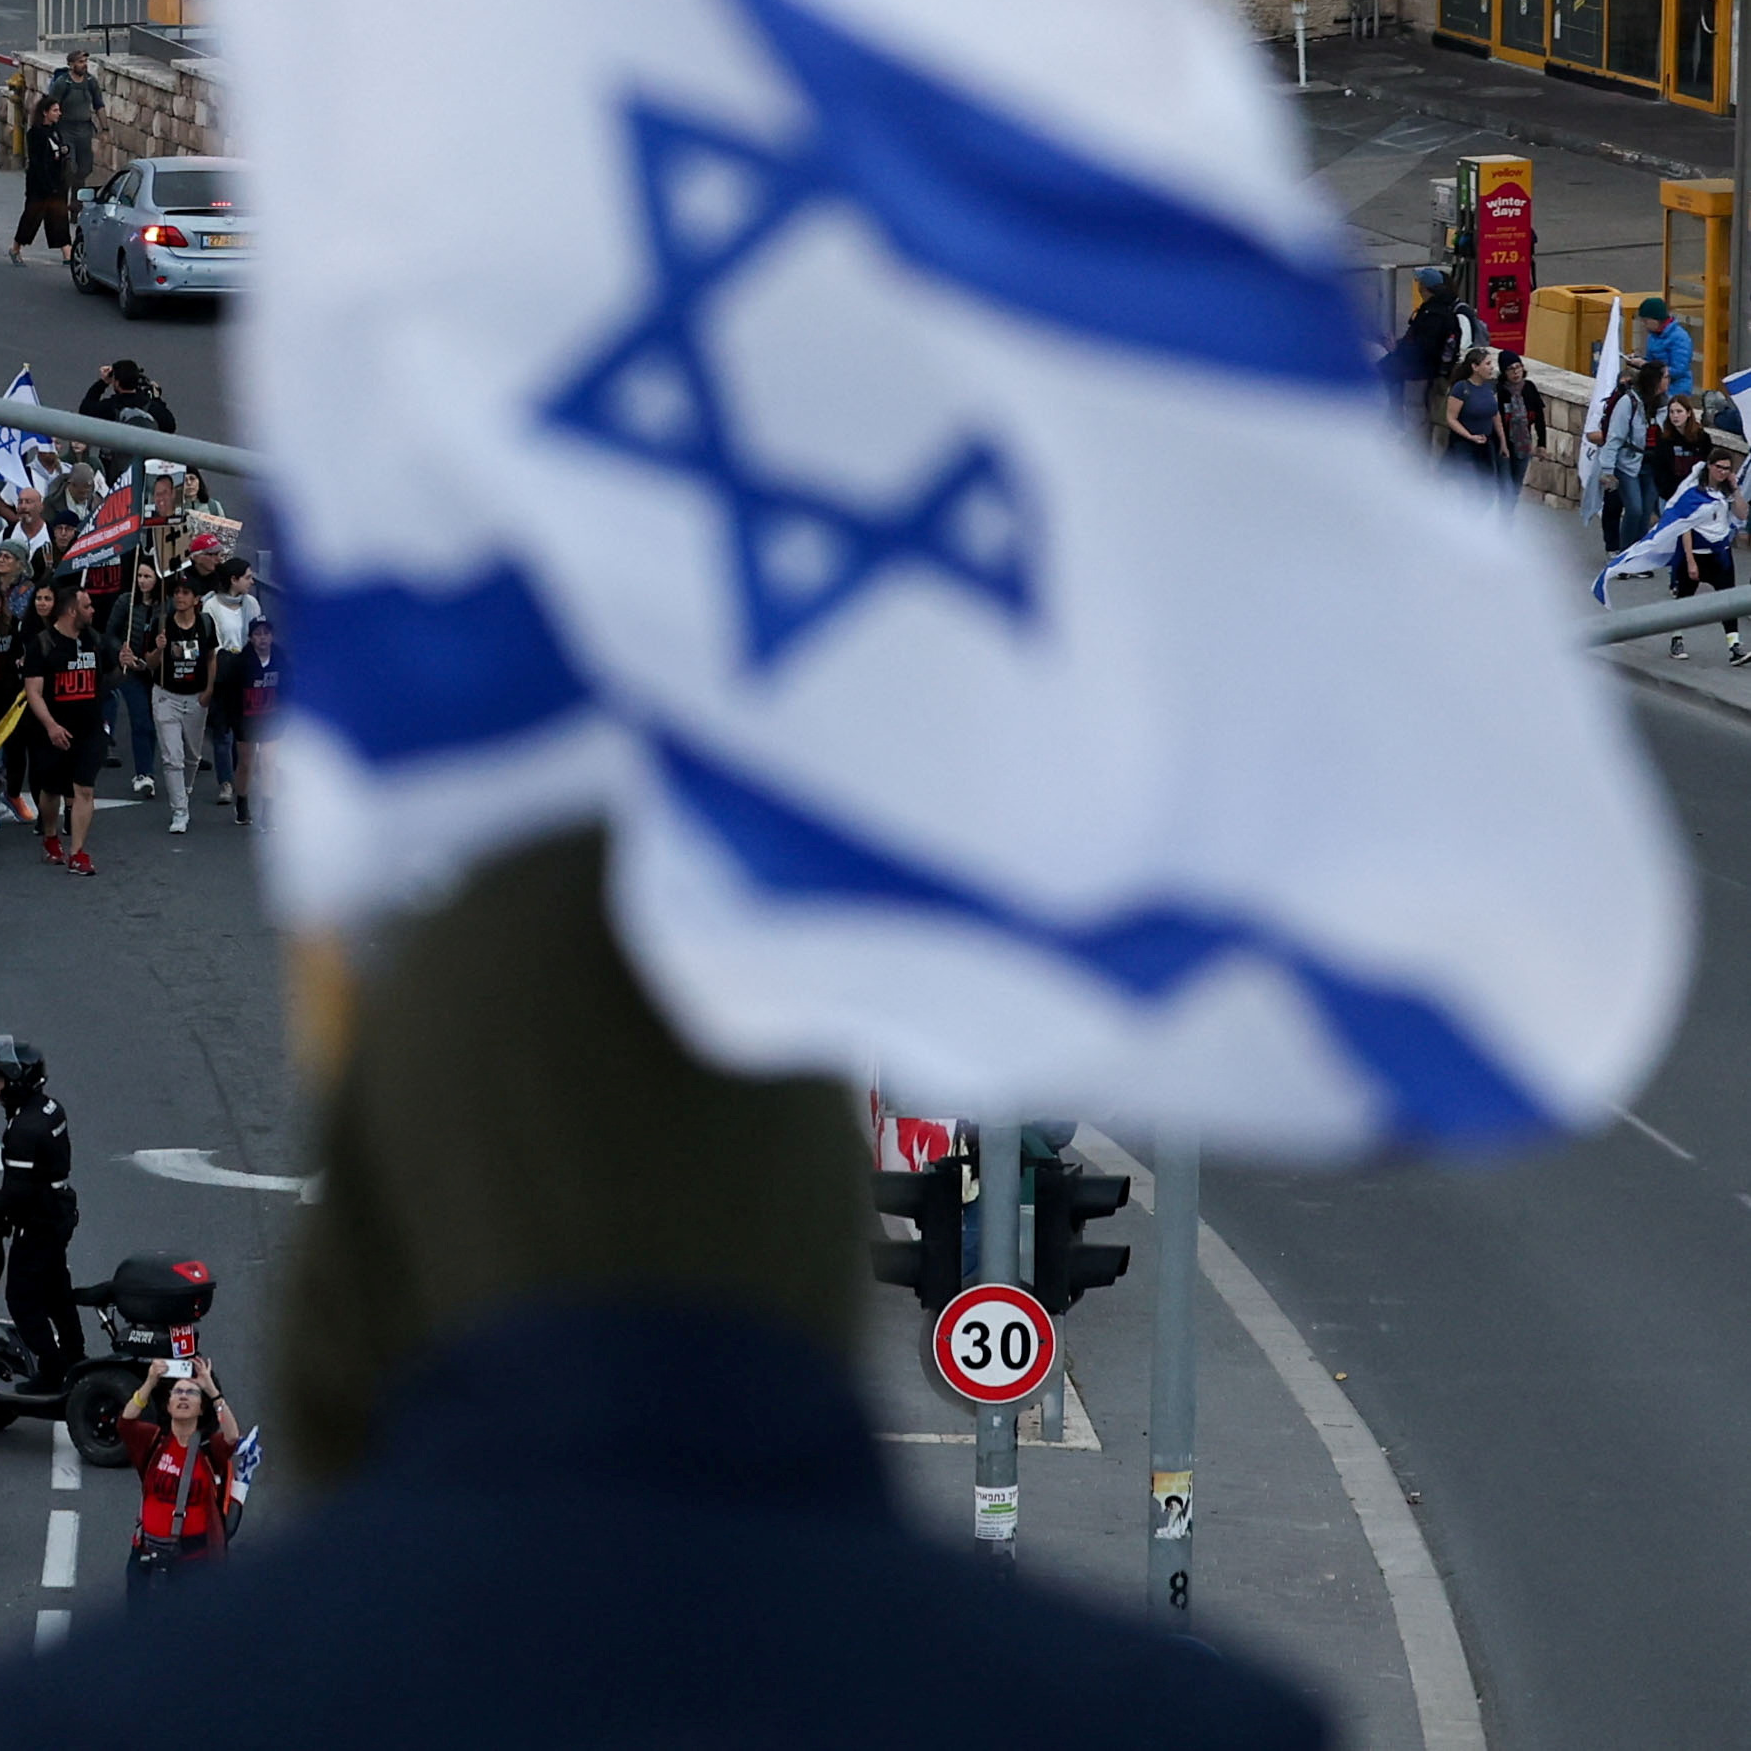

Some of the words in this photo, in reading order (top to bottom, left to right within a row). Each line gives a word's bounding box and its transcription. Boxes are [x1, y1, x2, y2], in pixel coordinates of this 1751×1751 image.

[1491, 168, 1524, 179] yellow
[1486, 197, 1527, 210] winter
[1492, 206, 1521, 218] days
[1490, 251, 1518, 264] 17.9
[960, 1320, 1032, 1371] 30
